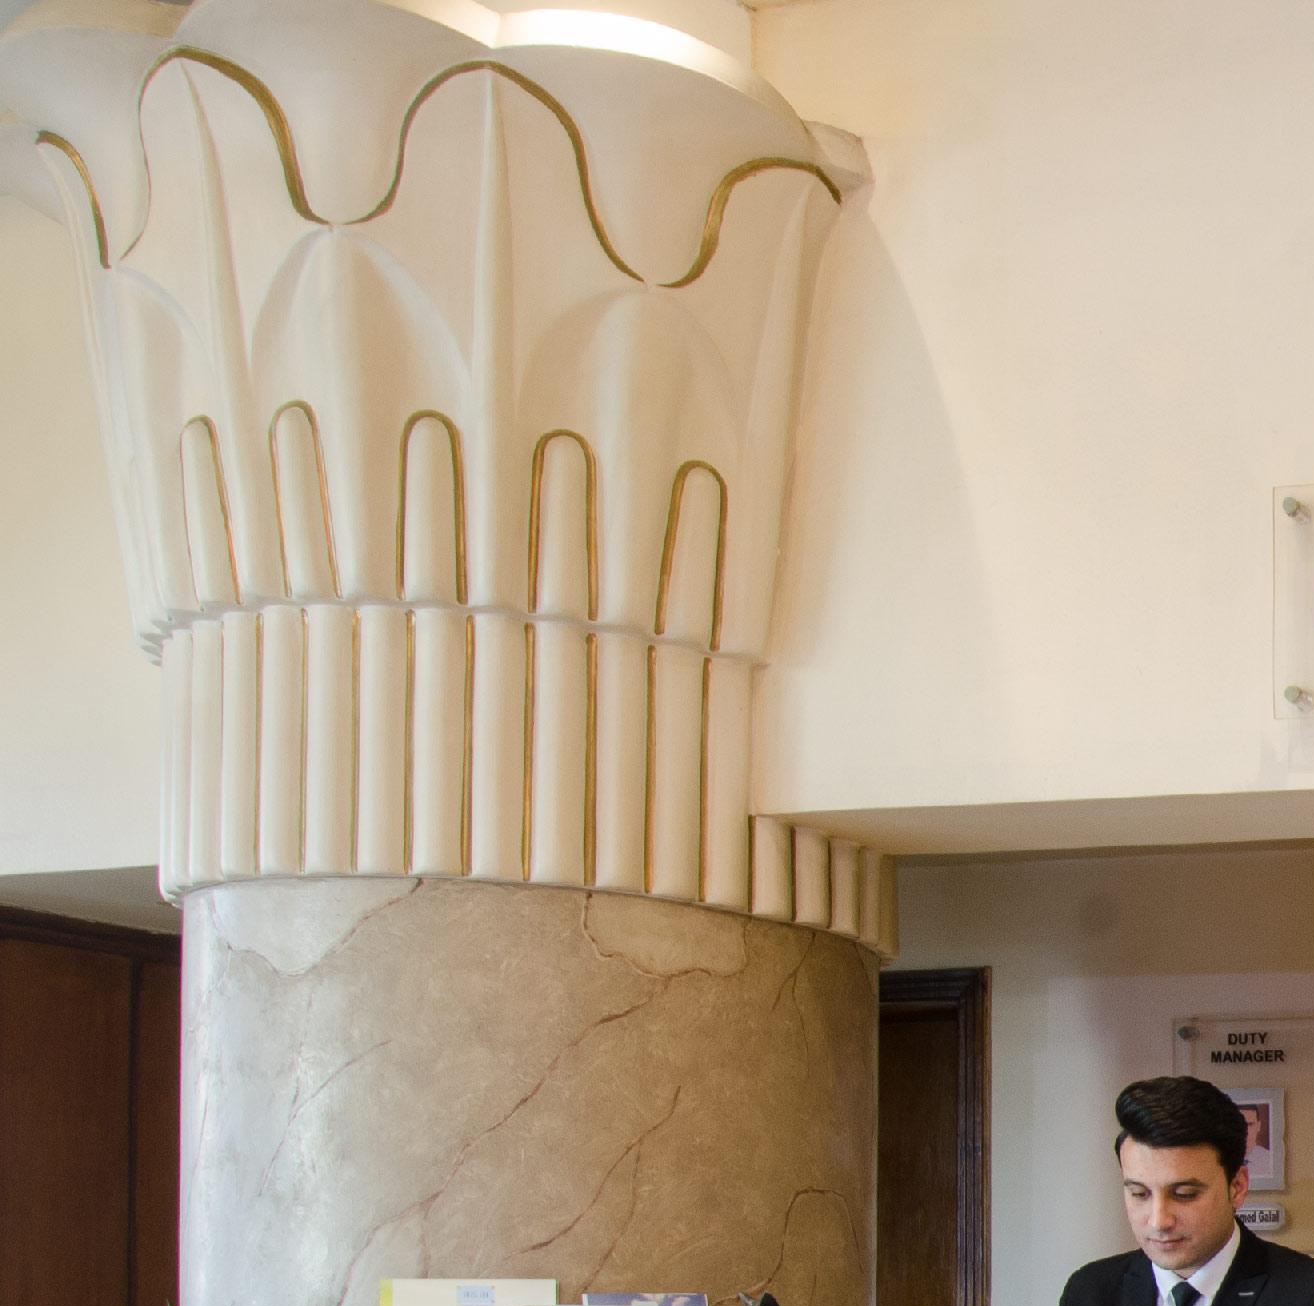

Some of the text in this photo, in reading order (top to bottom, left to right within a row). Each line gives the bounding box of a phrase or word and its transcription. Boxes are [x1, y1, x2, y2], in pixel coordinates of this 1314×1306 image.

[1227, 1032, 1267, 1046] DUTY
[1210, 1050, 1285, 1063] MANAGER
[1259, 1210, 1280, 1223] Galal
